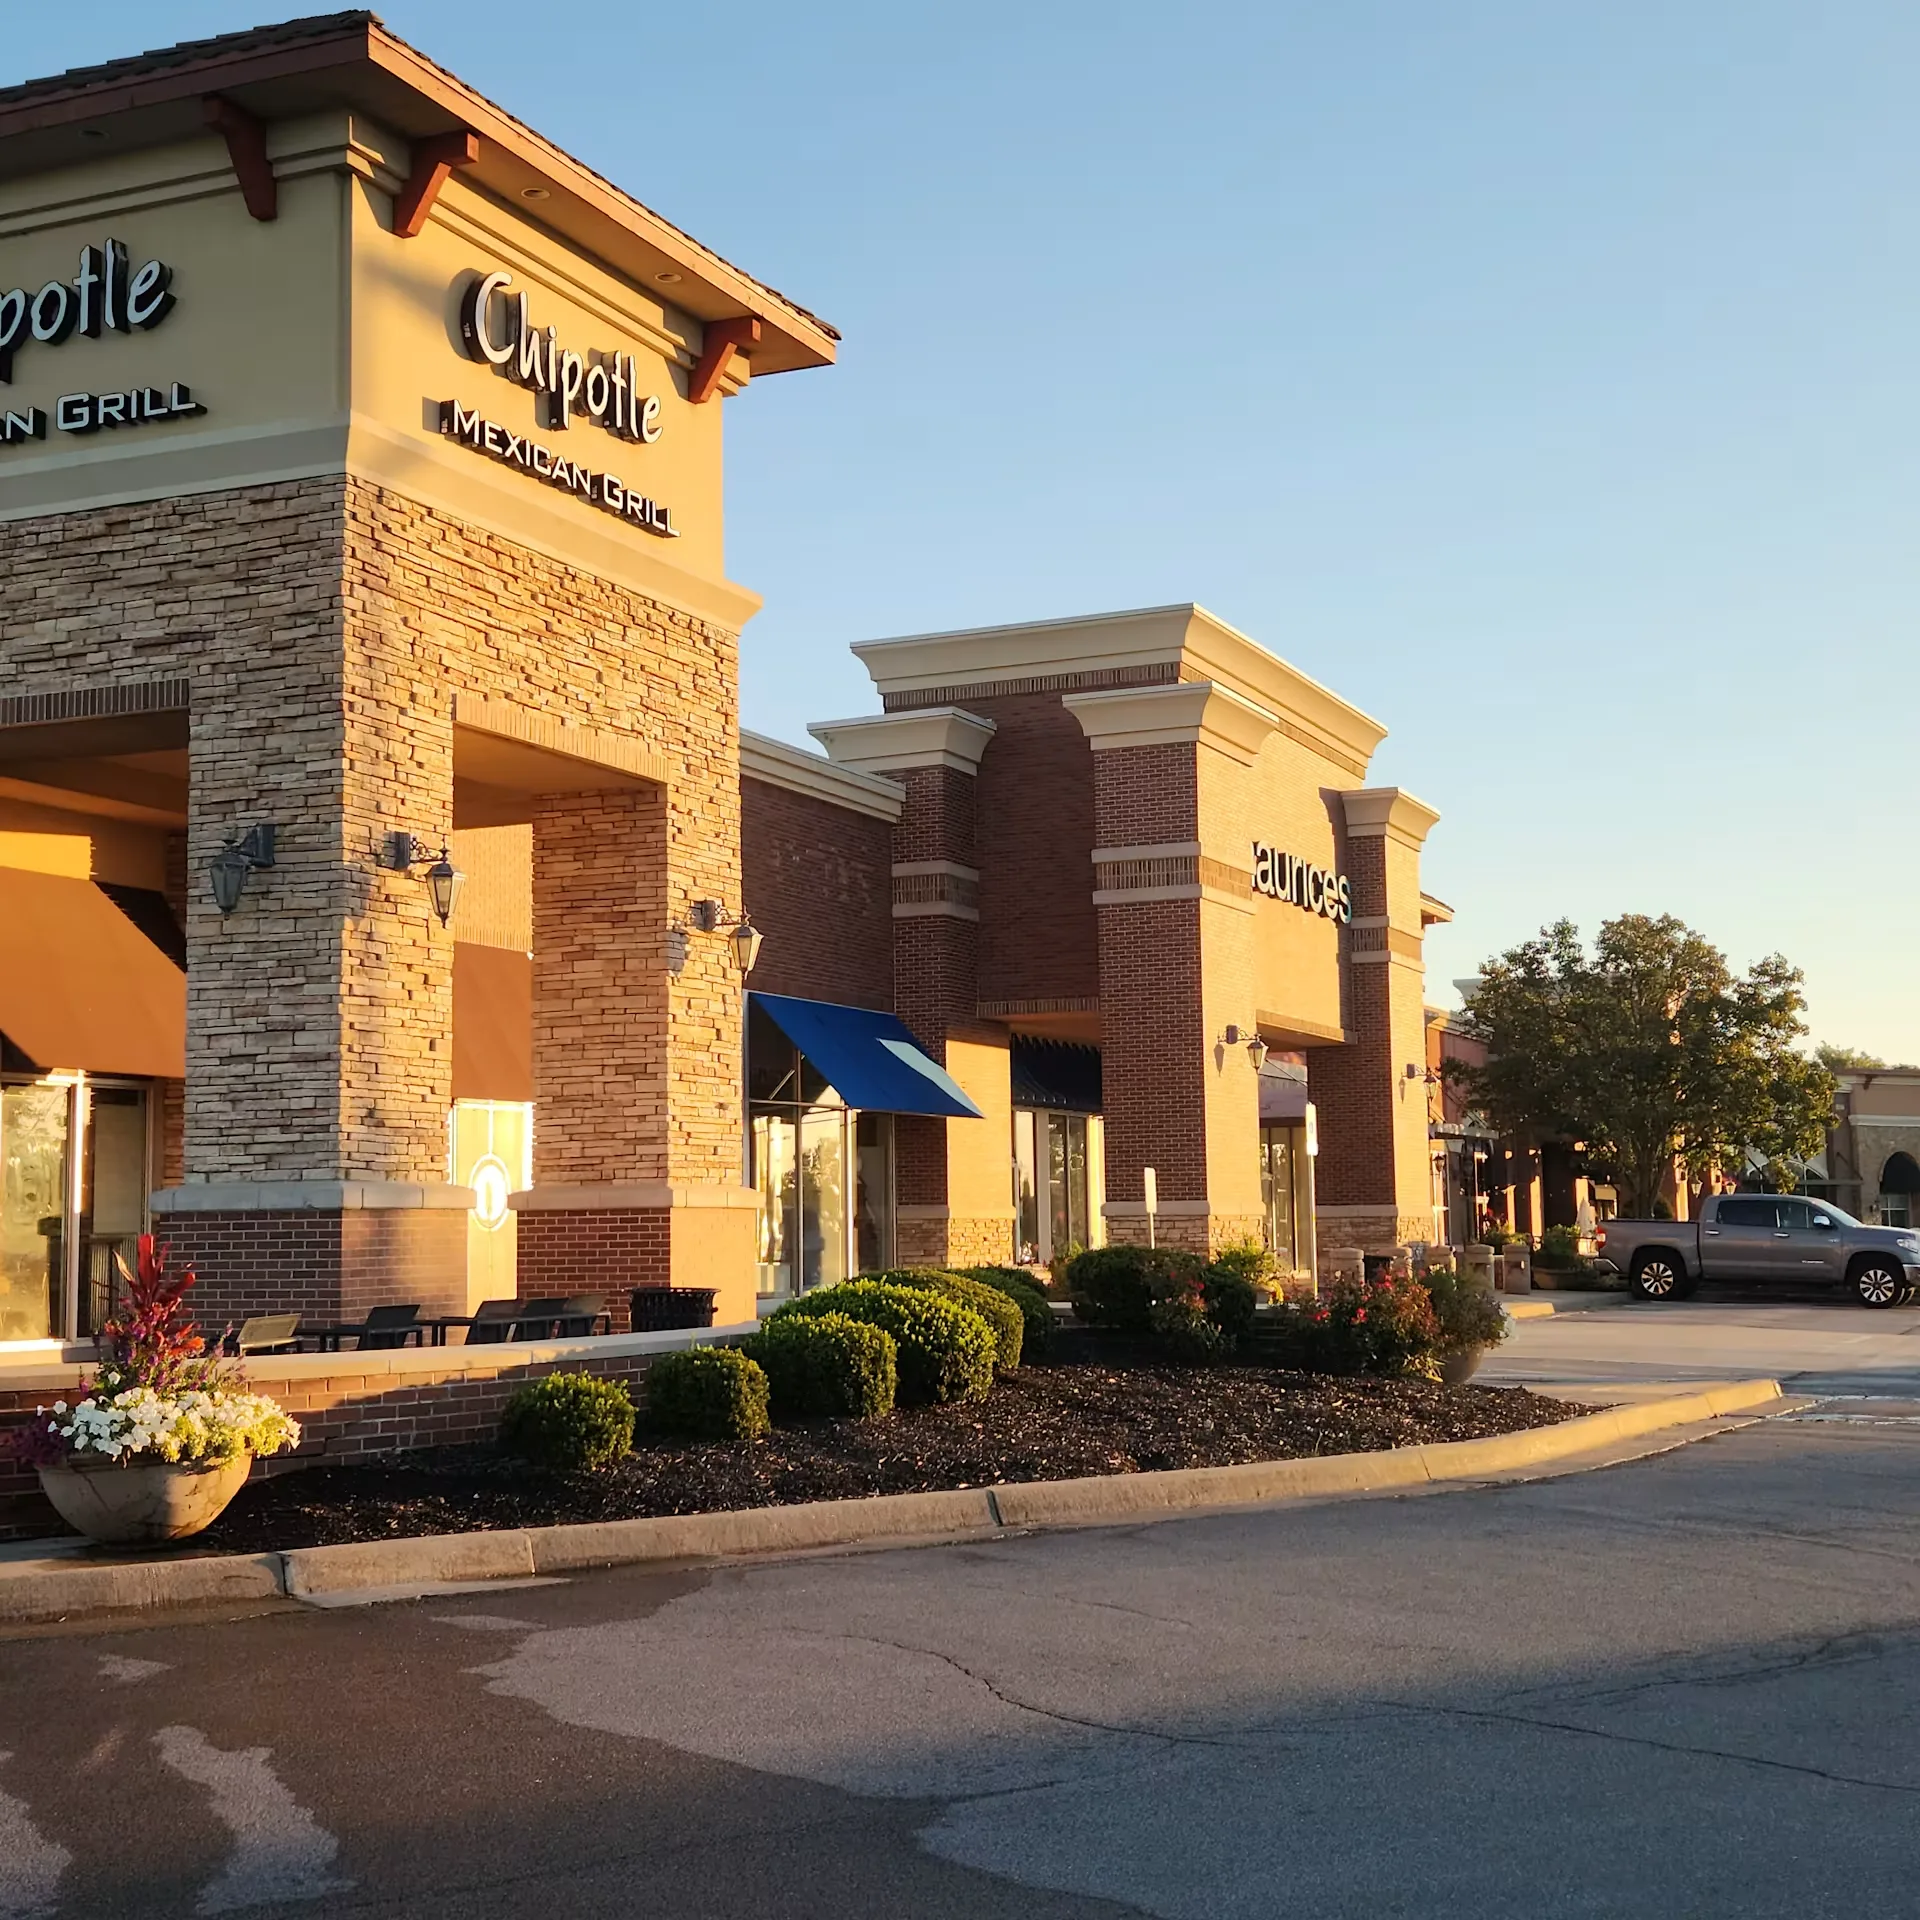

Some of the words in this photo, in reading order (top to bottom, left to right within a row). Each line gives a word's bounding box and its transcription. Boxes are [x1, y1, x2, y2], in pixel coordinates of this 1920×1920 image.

[57, 382, 203, 432] GRILL
[464, 271, 663, 444] Chipotle
[448, 399, 592, 496] MEXICAN
[601, 473, 681, 538] GRILL
[1251, 840, 1352, 924] aurices
